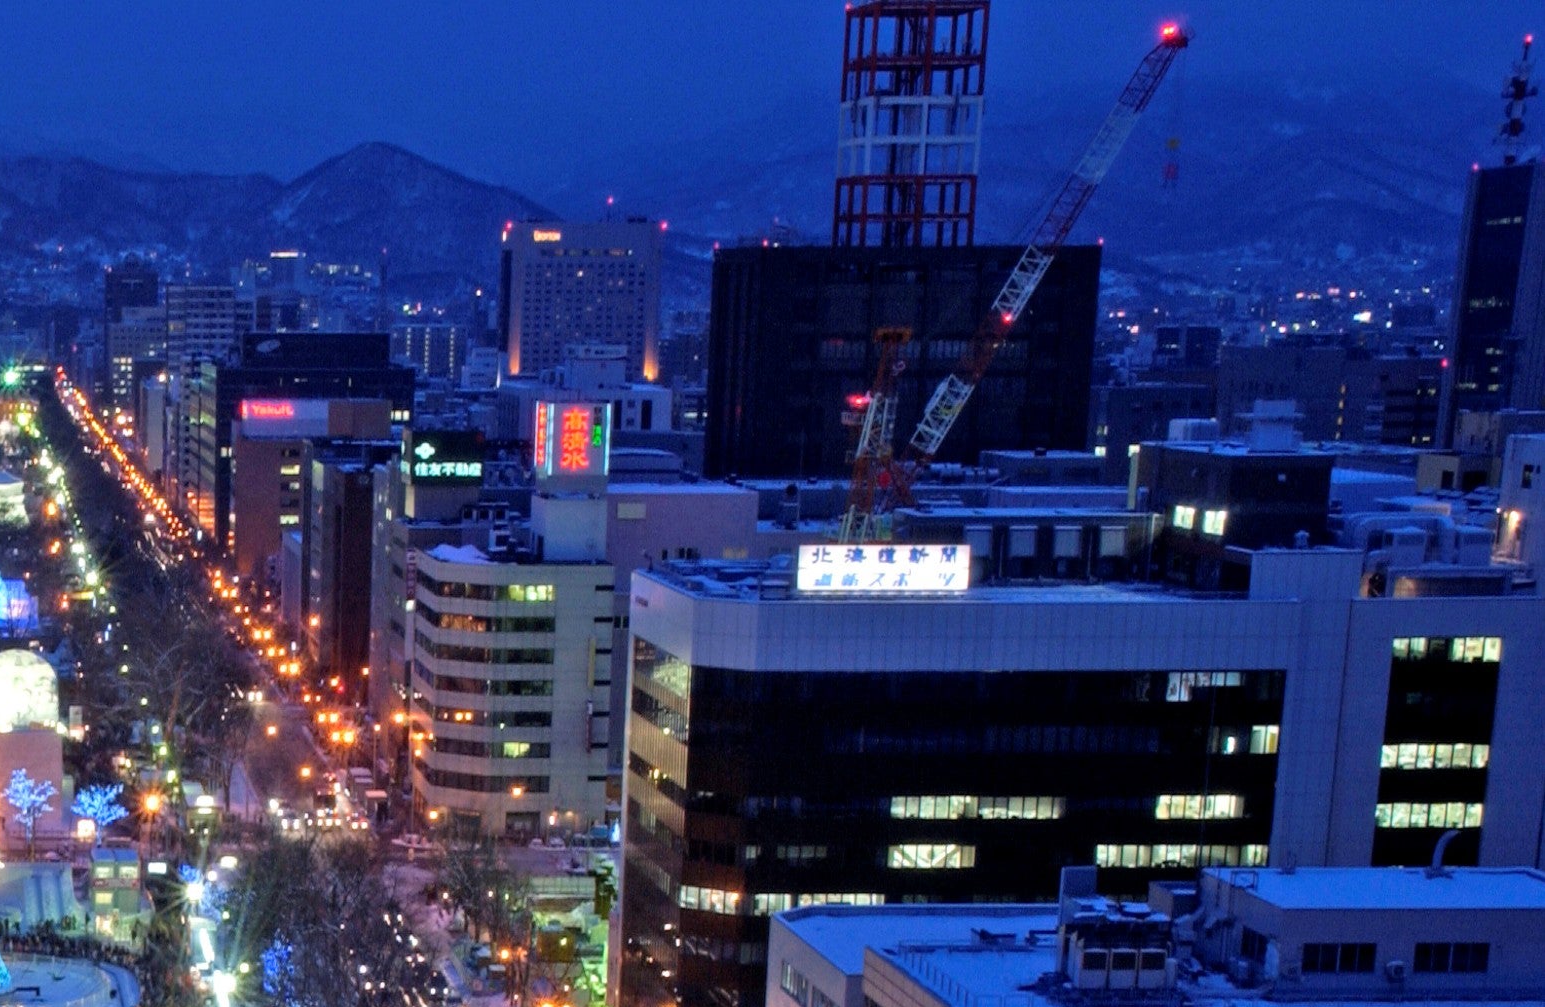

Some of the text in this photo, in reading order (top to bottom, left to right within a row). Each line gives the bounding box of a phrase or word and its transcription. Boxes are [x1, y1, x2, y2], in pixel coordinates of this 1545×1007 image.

[414, 462, 483, 478] 住友不動産
[812, 547, 958, 564] 北海道新聞
